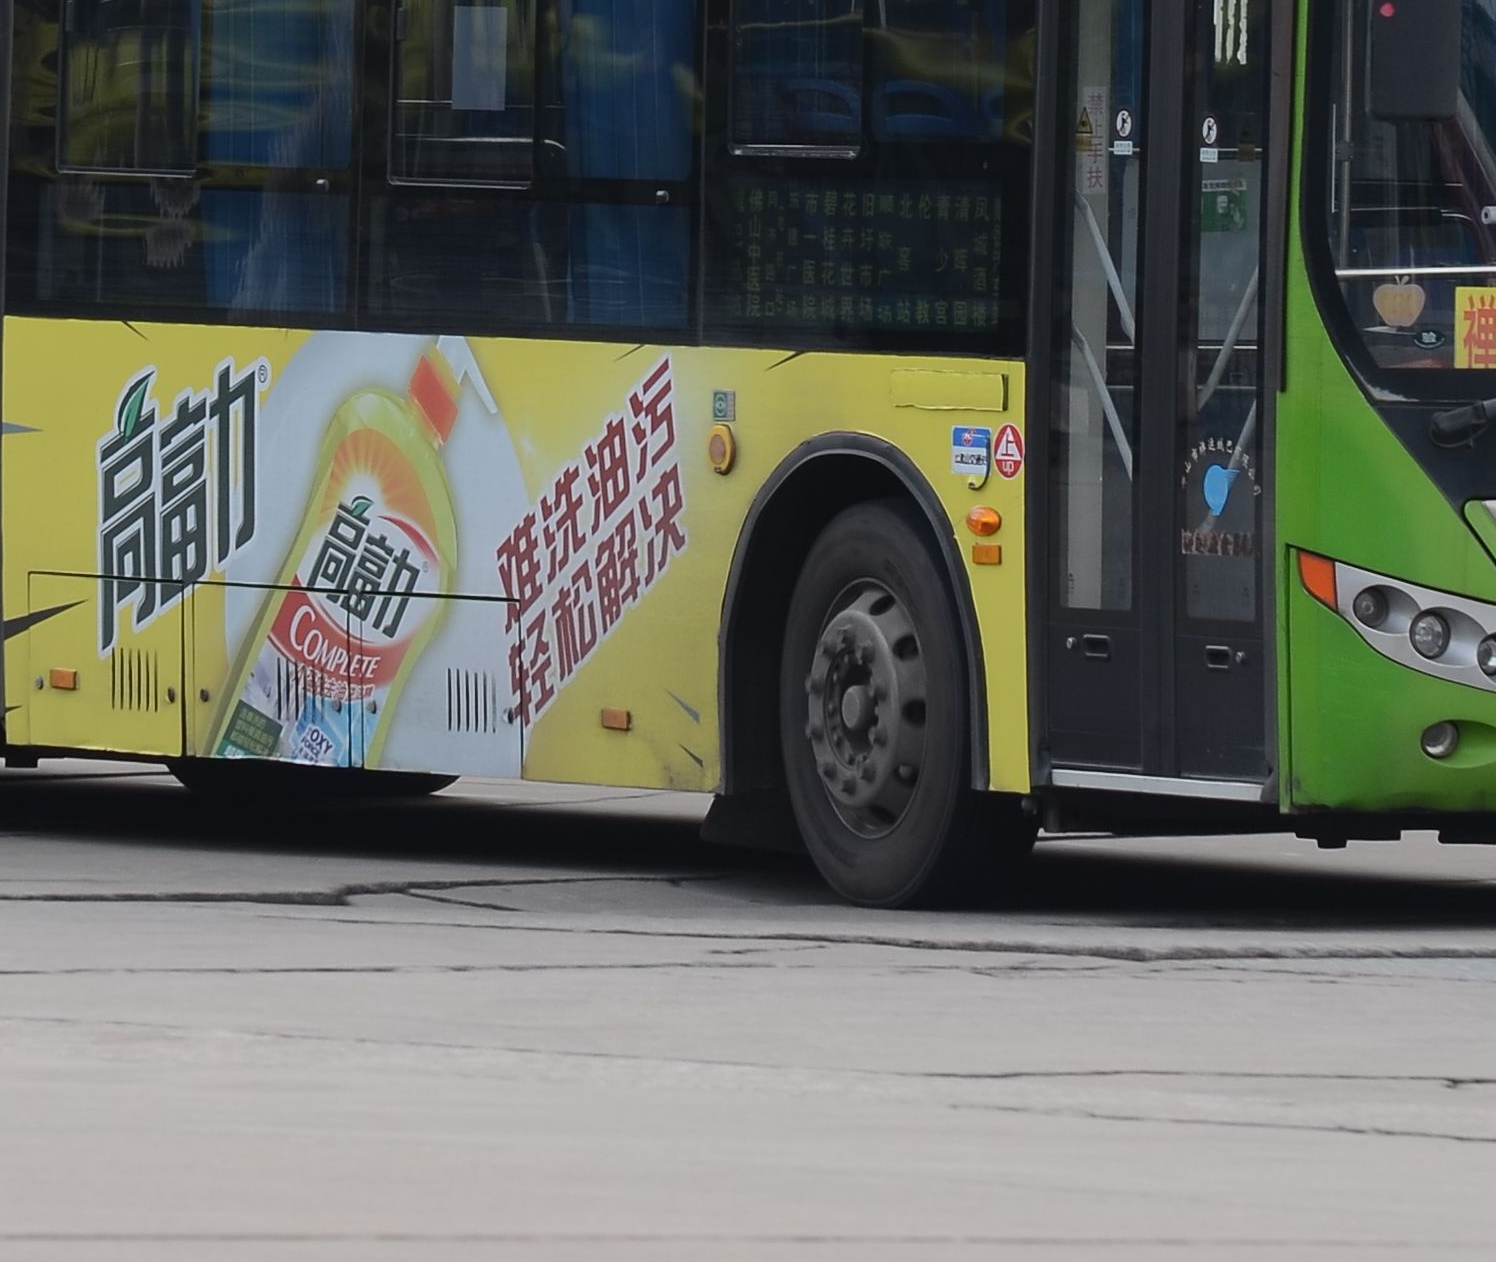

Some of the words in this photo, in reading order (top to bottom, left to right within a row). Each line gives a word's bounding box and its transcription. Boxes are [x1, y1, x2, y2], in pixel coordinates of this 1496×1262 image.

[1001, 434, 1014, 457] 上
[497, 358, 675, 634] 难洗油污
[508, 463, 686, 728] 轻松解决
[290, 605, 381, 678] COMPLETE
[310, 729, 333, 754] OXY
